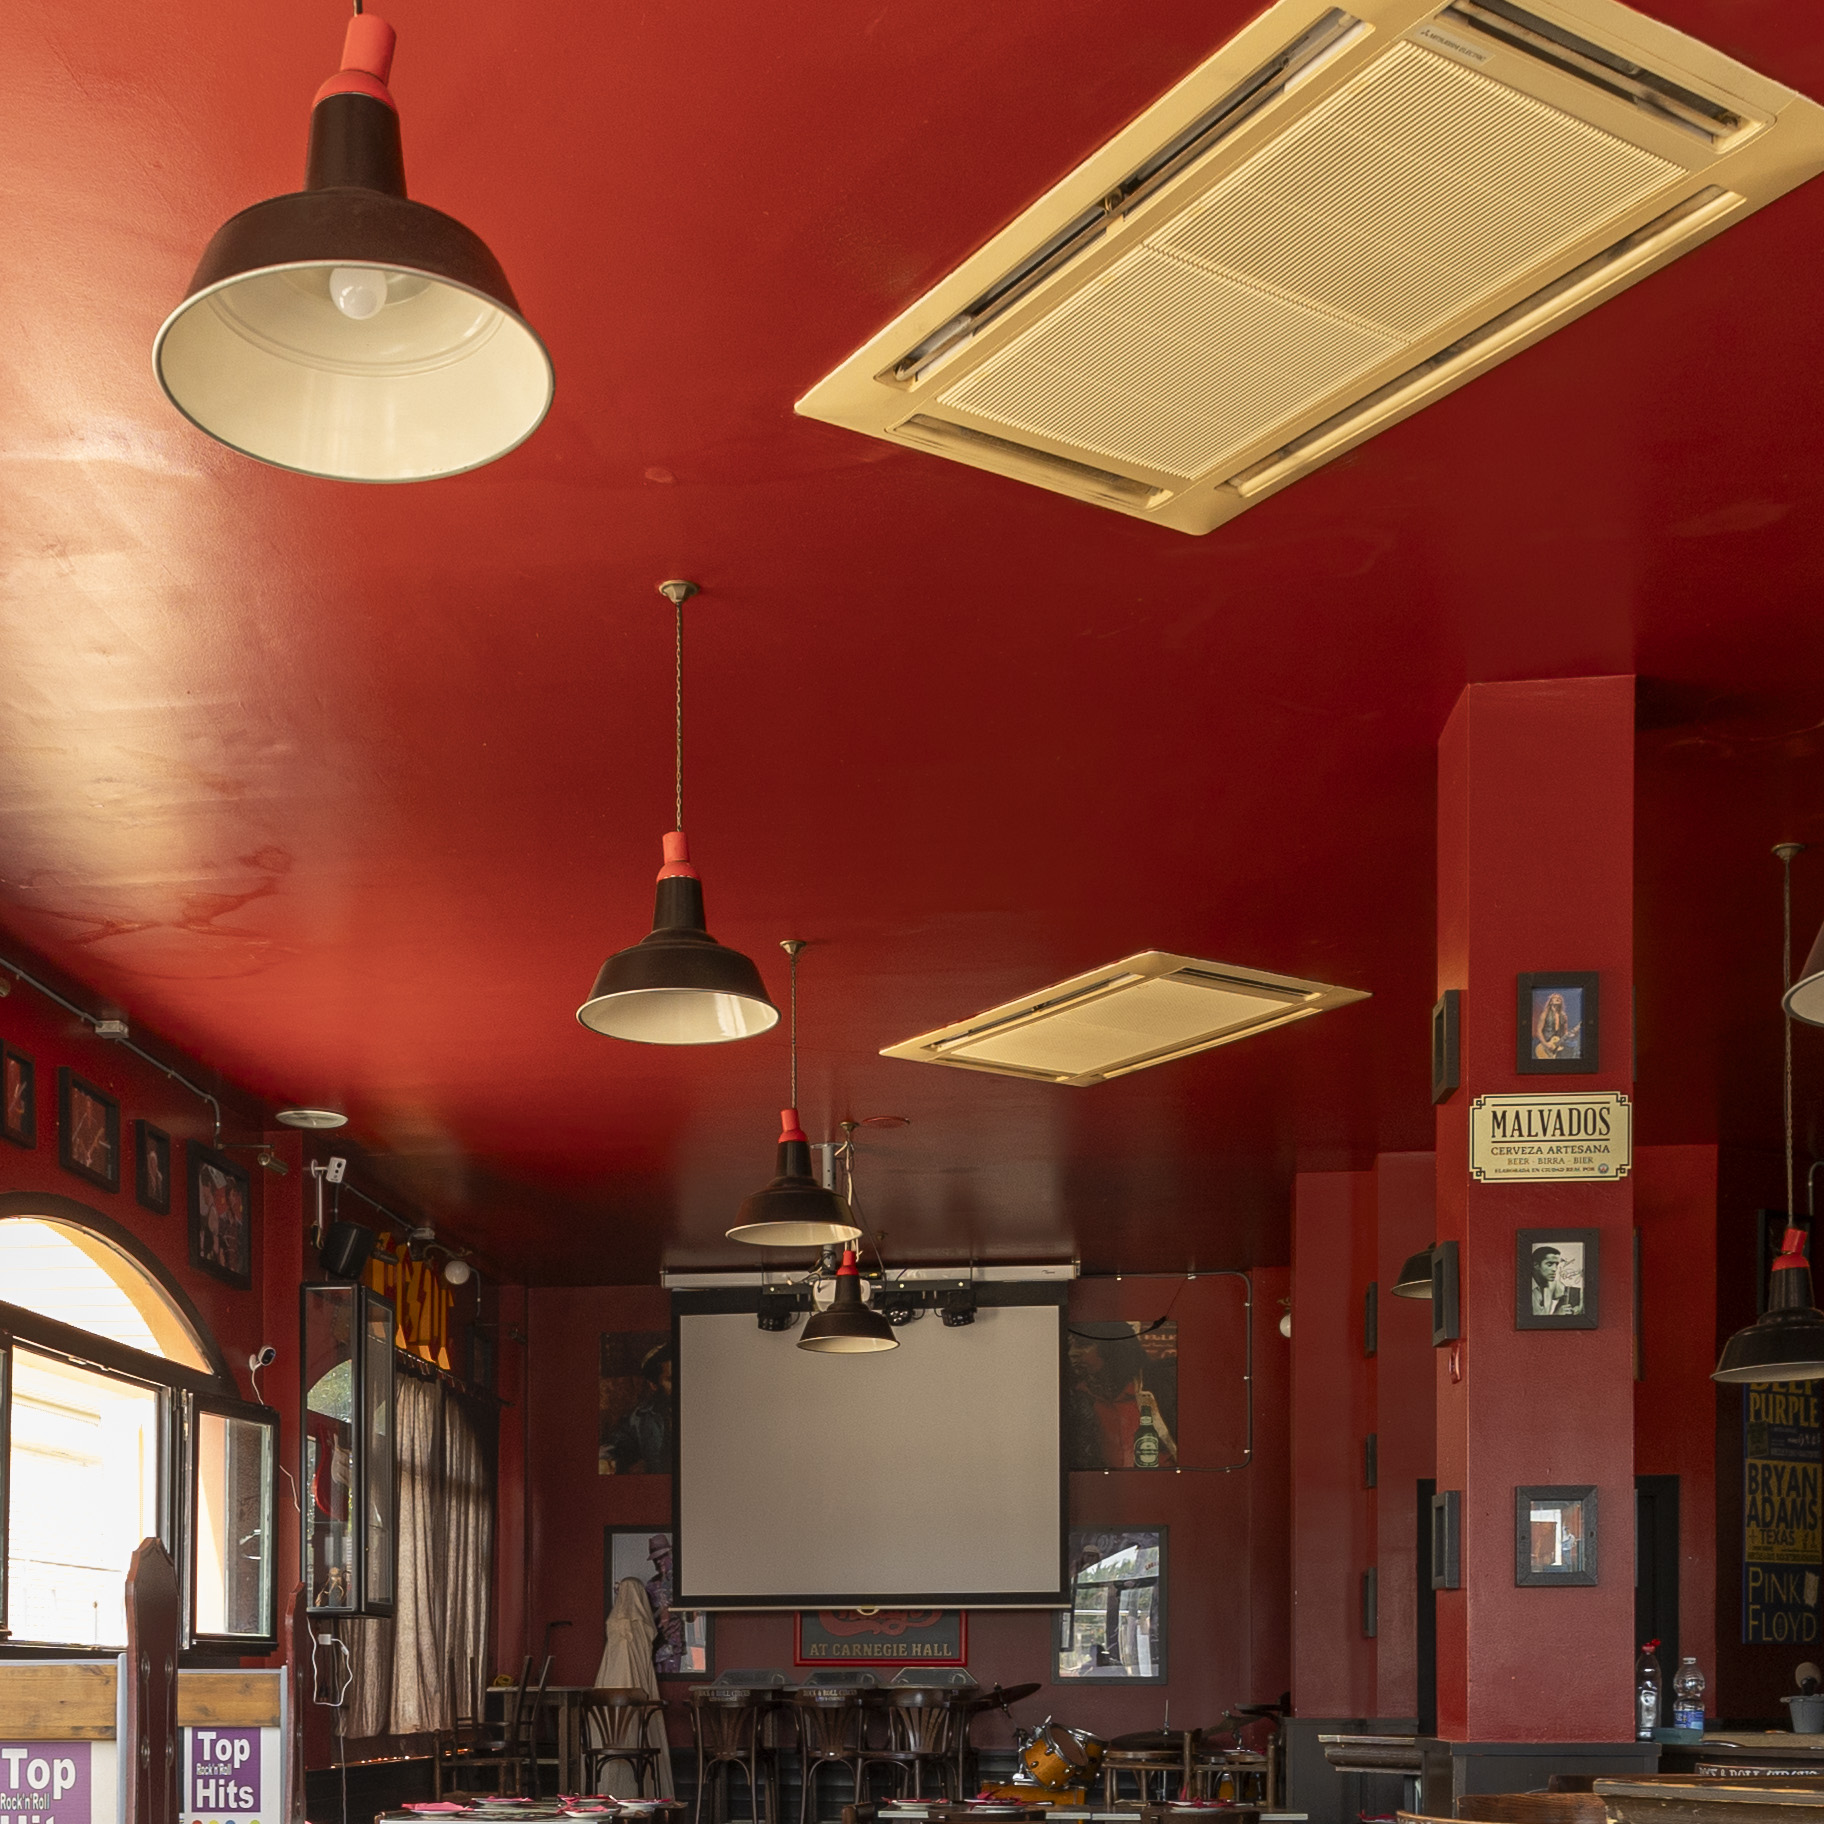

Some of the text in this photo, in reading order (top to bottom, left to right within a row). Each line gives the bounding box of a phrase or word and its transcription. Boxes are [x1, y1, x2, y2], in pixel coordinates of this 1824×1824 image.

[1490, 1106, 1611, 1138] MALVADOS
[1490, 1144, 1611, 1156] CERVEZA ARTESANA
[1507, 1156, 1594, 1166] BEER BIRRA BIER
[1749, 1391, 1820, 1428] PURPLE
[1747, 1462, 1818, 1499] BRYAN
[1746, 1495, 1819, 1531] ADAMS
[1748, 1567, 1801, 1604] PINK
[1748, 1604, 1817, 1642] FLOYD
[809, 1642, 952, 1657] AT CARNEGIE HALL
[197, 1731, 251, 1768] Top
[0, 1747, 76, 1799] Top
[196, 1778, 255, 1809] Hits
